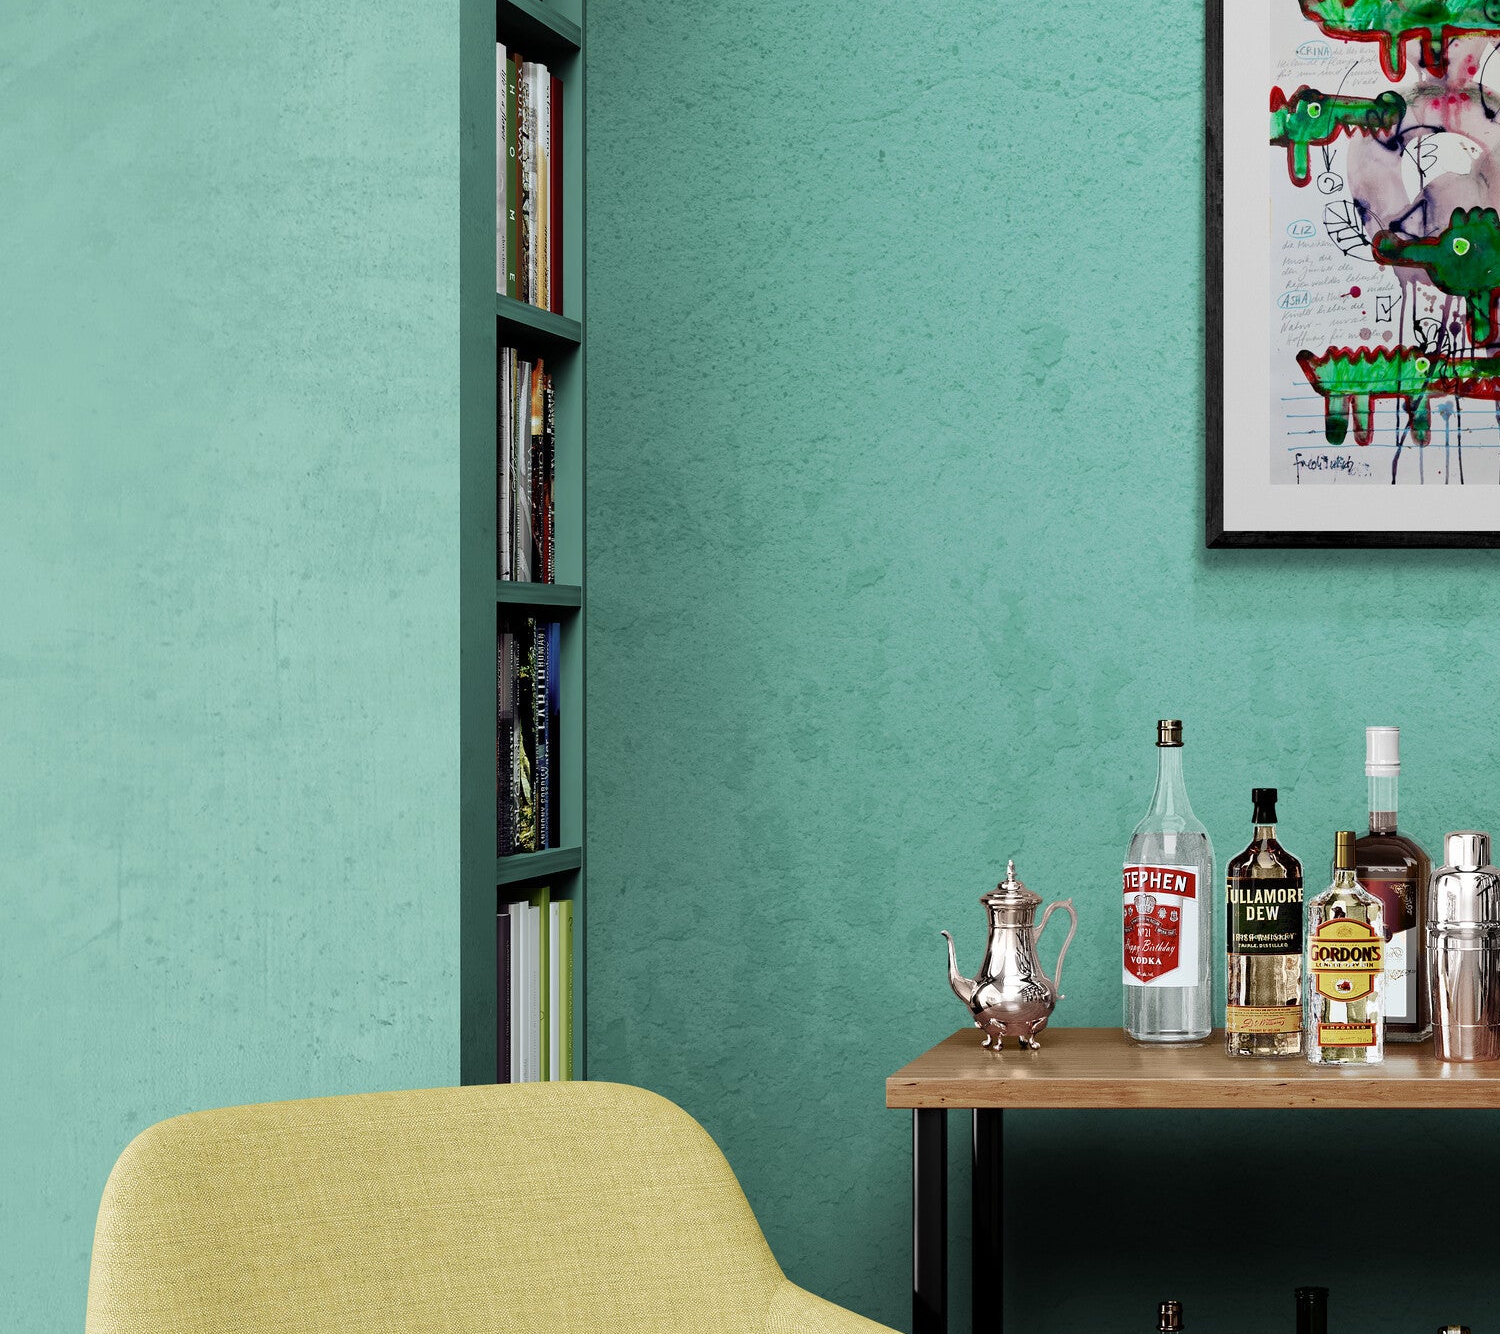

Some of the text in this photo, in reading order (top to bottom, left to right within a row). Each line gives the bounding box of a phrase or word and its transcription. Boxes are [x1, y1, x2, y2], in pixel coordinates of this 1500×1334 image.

[1299, 46, 1330, 57] CRINA
[1293, 224, 1312, 235] LIZ
[1281, 292, 1309, 308] ASHA
[1227, 885, 1303, 904] TULLAMORE
[1246, 906, 1280, 921] DEW
[1131, 956, 1162, 965] VODKA
[1311, 945, 1381, 962] GORDON'S
